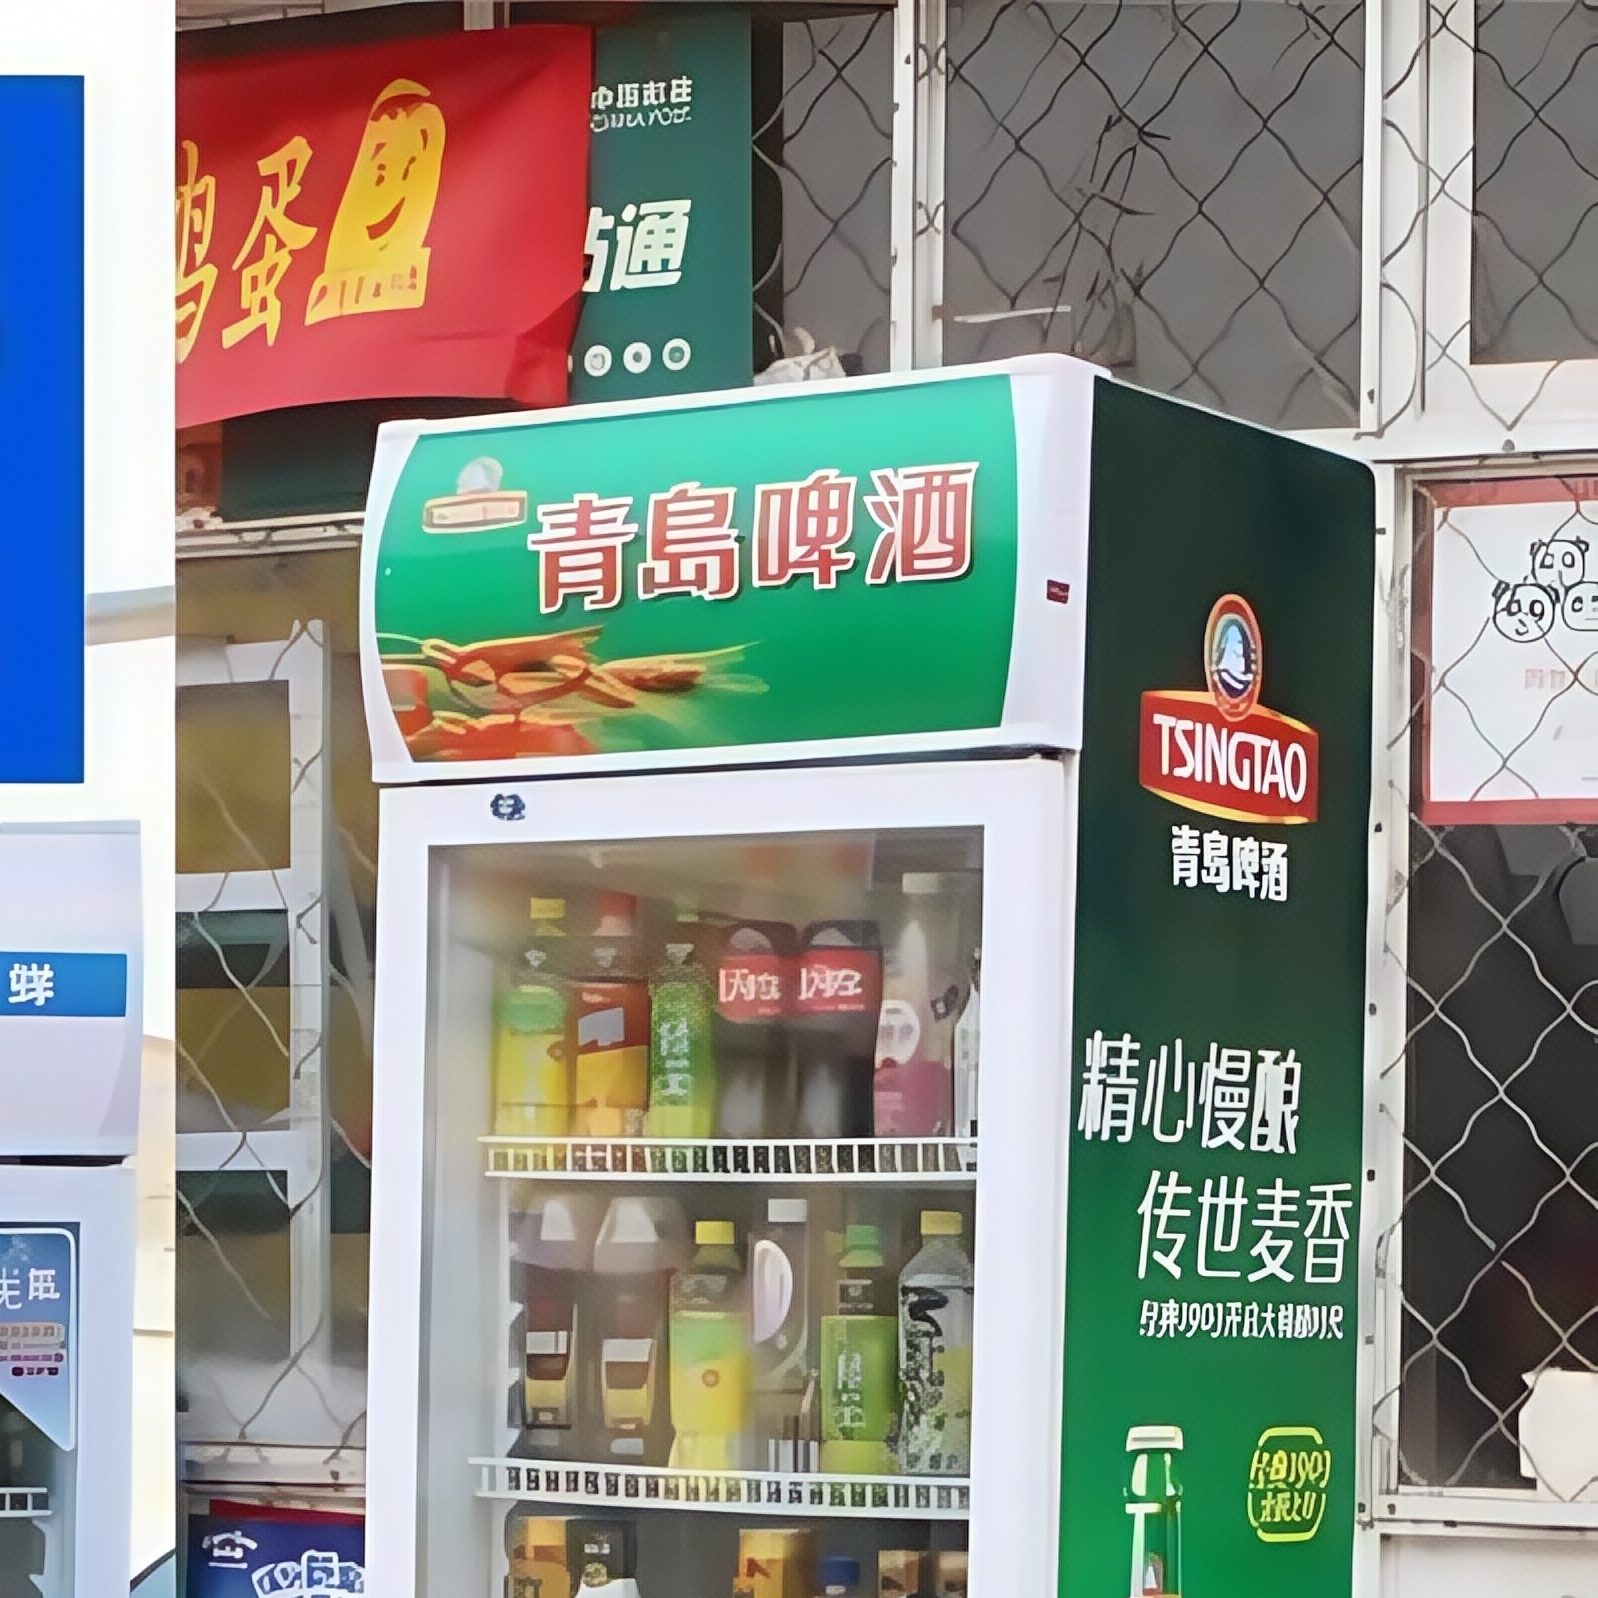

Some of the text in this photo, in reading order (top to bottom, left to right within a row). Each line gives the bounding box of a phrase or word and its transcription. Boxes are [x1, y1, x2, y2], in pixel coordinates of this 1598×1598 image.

[1153, 713, 1307, 803] TSINGTAO
[1137, 1169, 1353, 1283] 传世麦香
